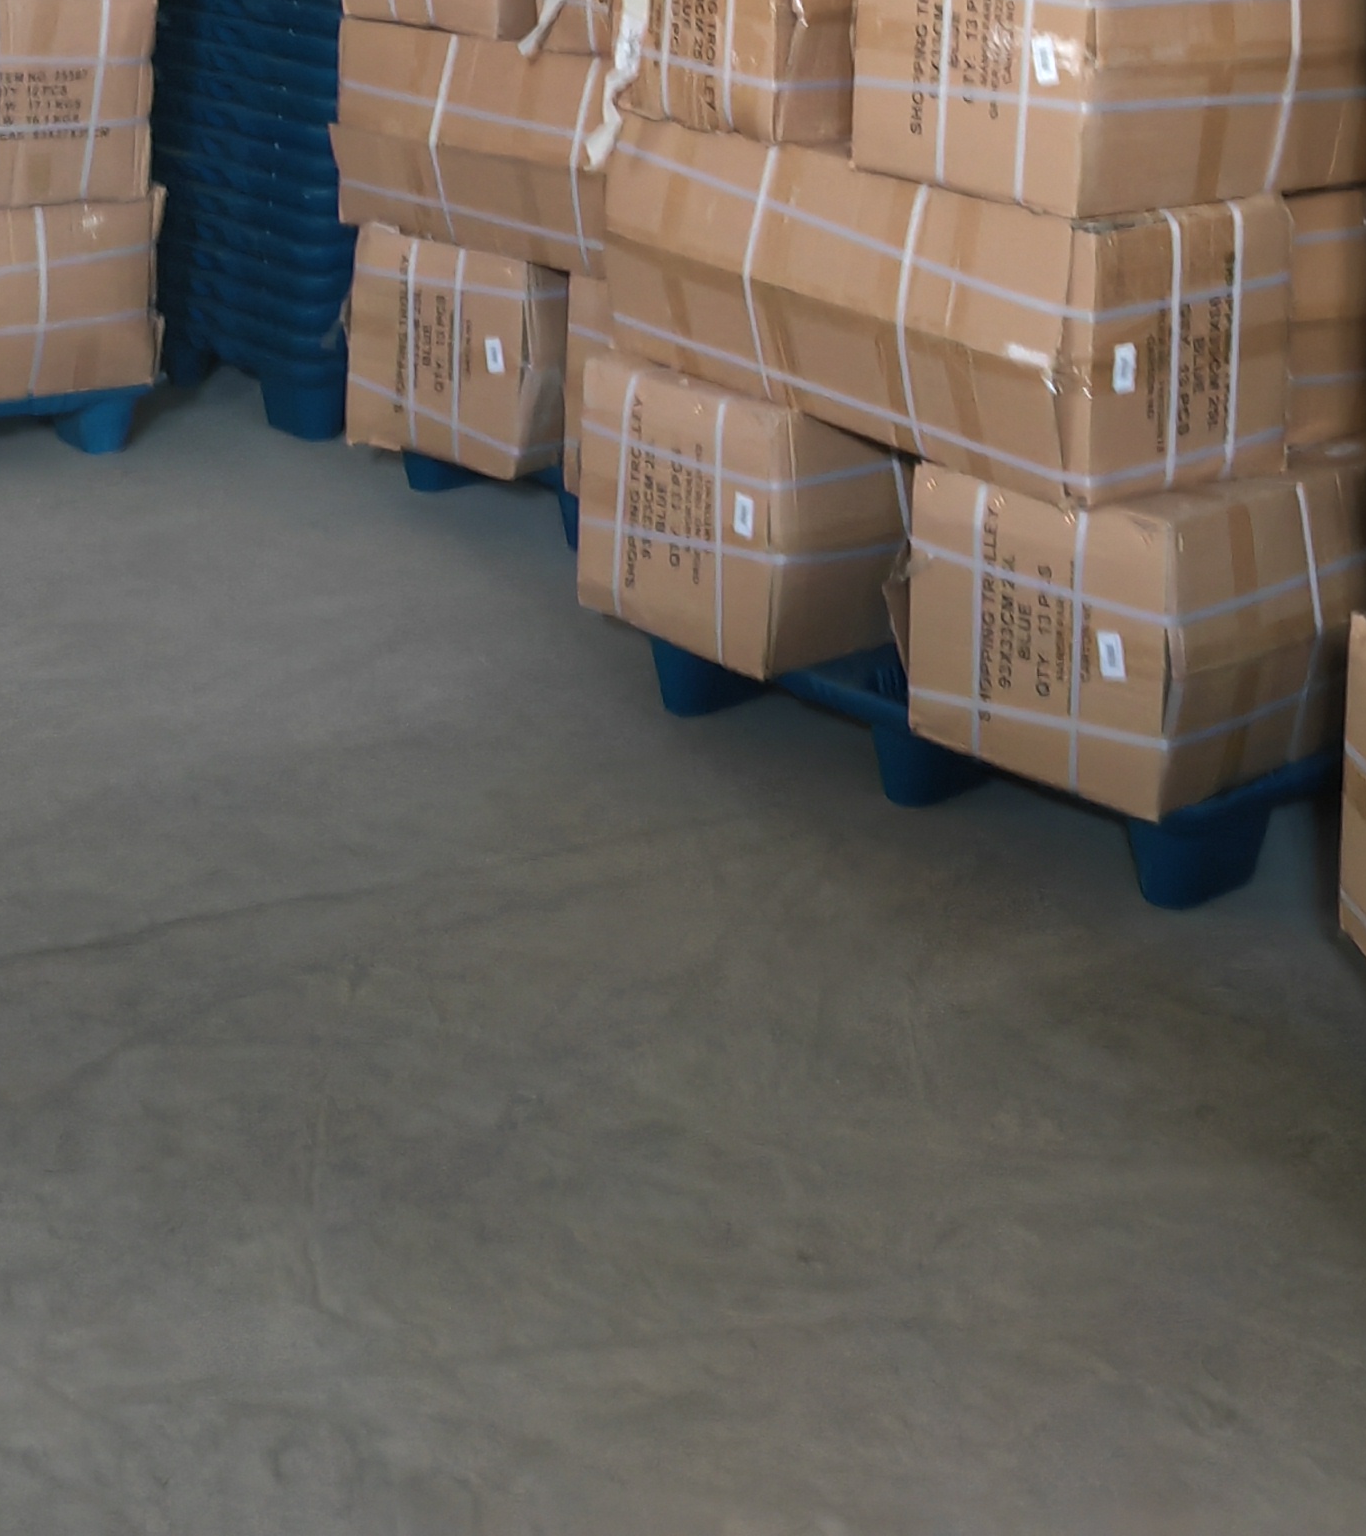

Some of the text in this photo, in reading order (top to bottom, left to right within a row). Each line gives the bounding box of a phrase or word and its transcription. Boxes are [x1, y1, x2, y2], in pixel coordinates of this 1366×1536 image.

[655, 484, 667, 534] BLUE
[997, 593, 1015, 690] 93X33CM
[1017, 602, 1032, 662] BLUE
